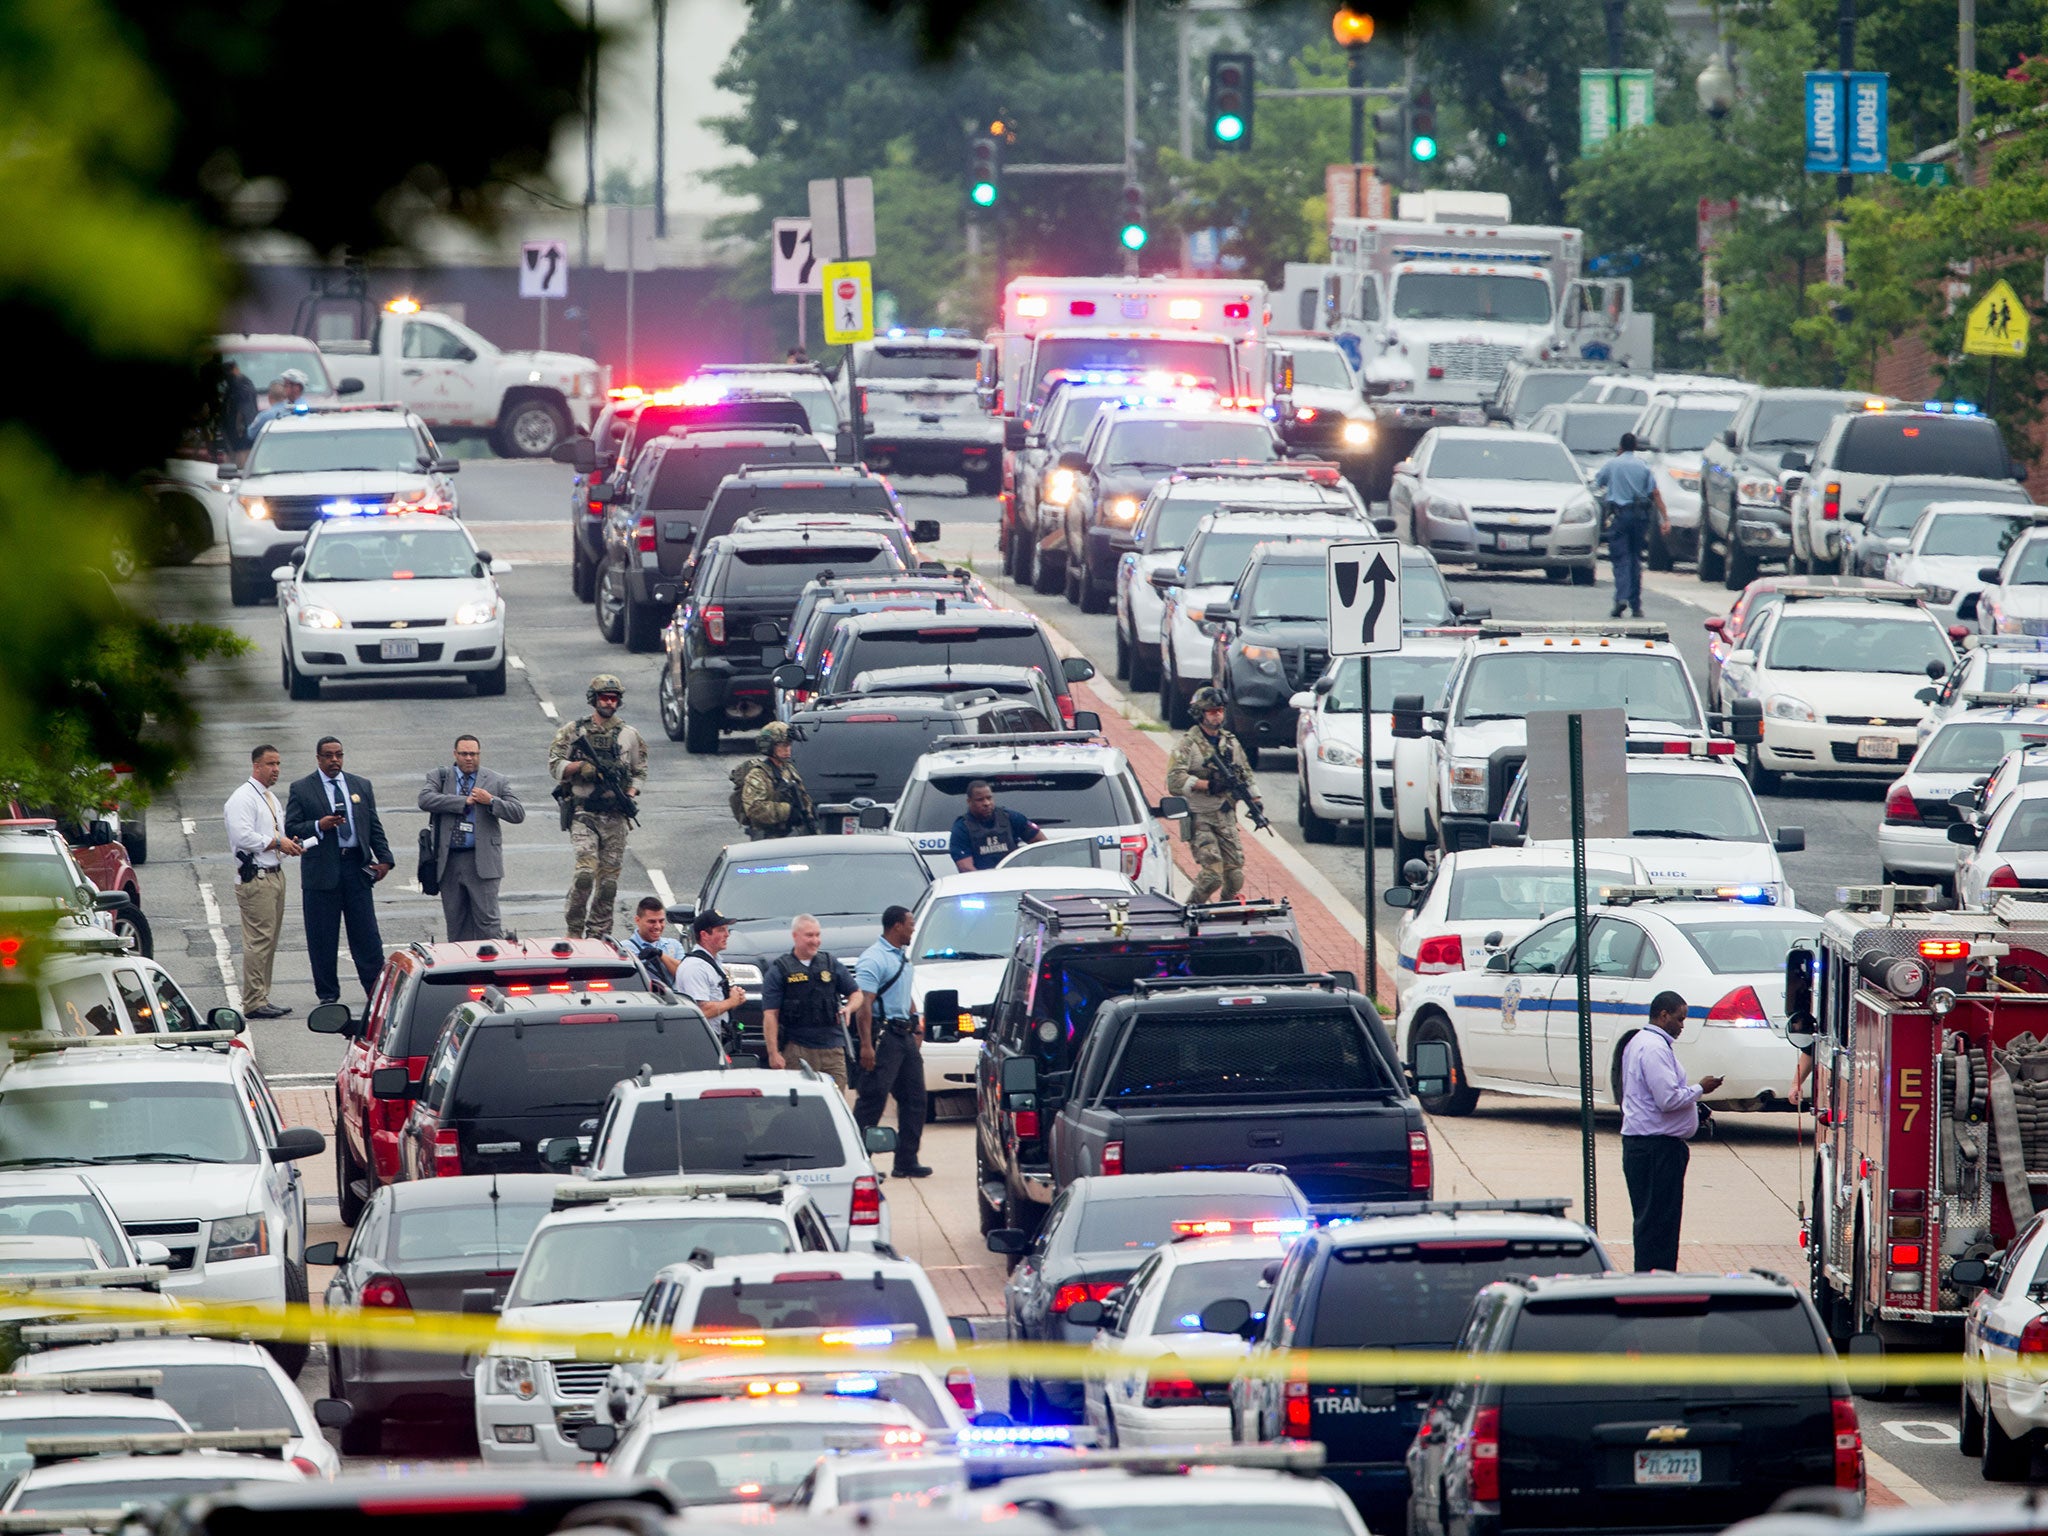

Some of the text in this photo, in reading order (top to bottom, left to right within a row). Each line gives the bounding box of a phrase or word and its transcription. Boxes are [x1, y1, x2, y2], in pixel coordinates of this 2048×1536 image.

[1814, 88, 1836, 149] FRONT
[1857, 89, 1878, 151] FRONT
[918, 838, 946, 849] SOD
[1900, 1068, 1923, 1098] E
[1900, 1103, 1921, 1132] 7
[796, 1174, 832, 1182] POLICE
